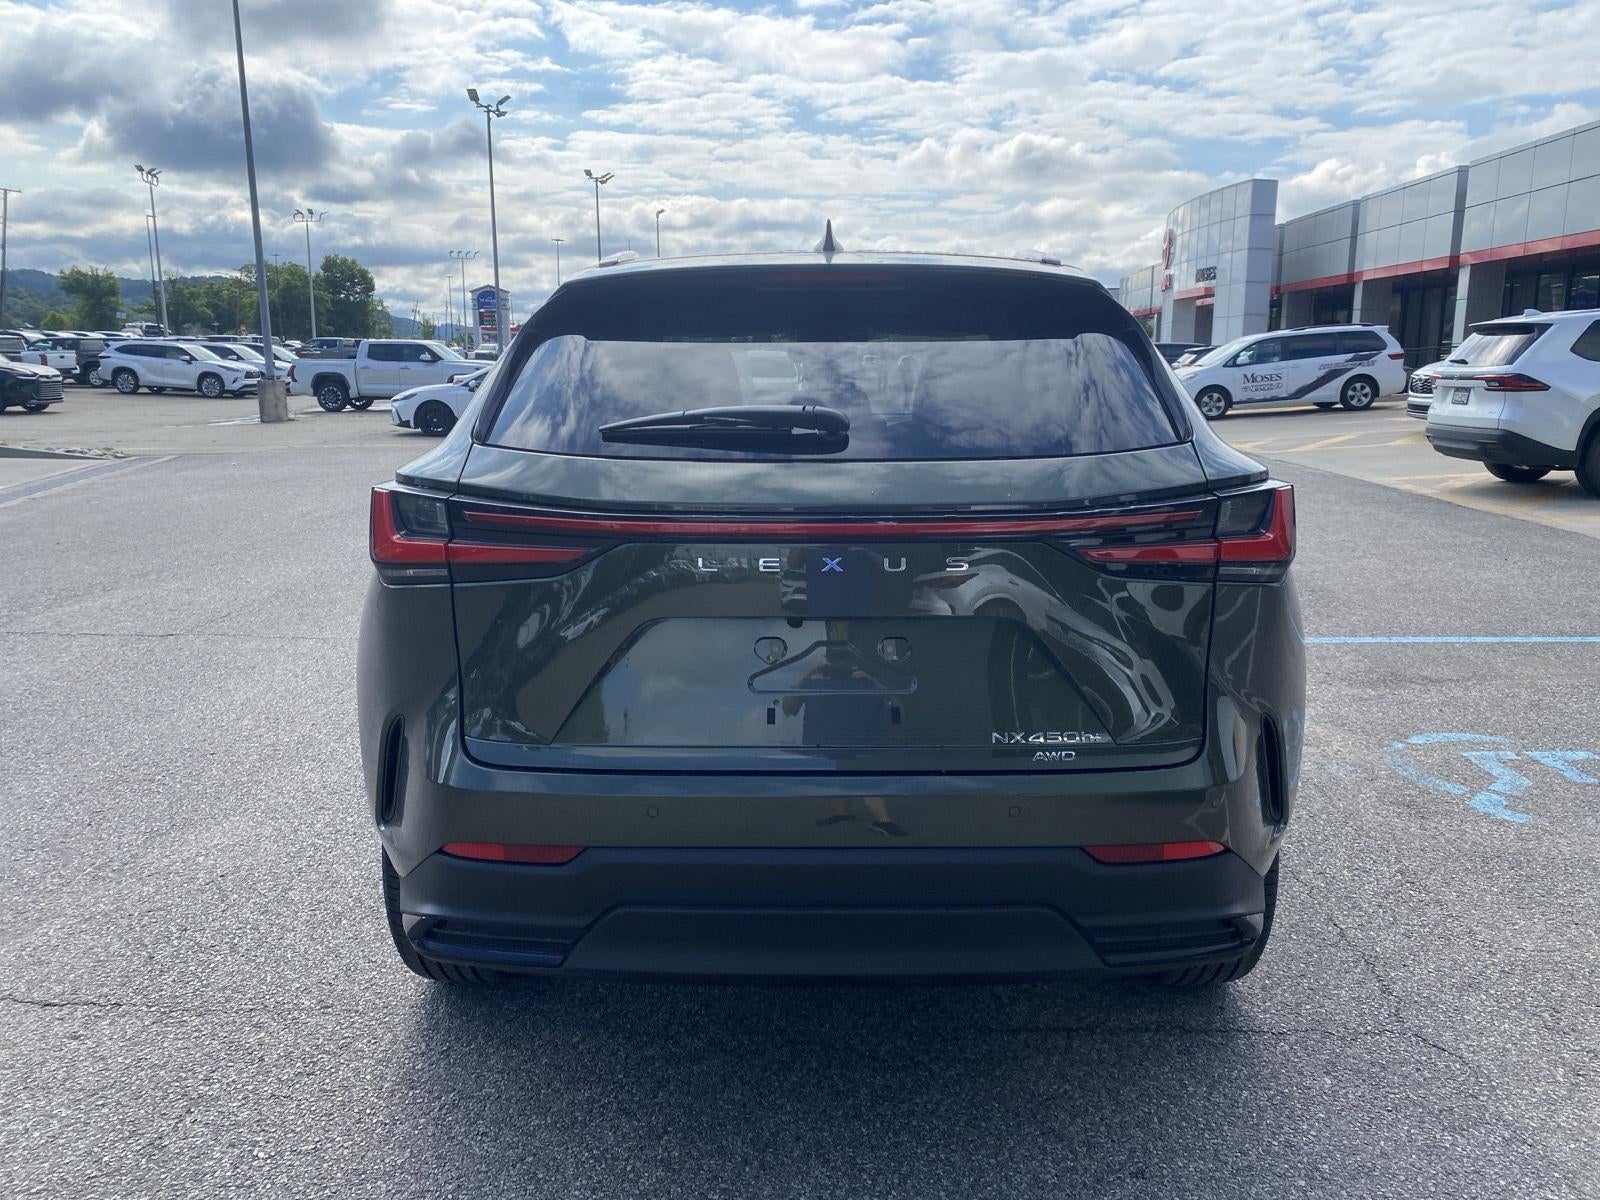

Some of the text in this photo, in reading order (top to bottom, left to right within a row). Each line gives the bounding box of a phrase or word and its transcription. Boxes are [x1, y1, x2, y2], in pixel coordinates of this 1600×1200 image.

[1242, 372, 1282, 384] MOSES
[697, 556, 969, 573] LEXUS
[1032, 751, 1076, 761] AWD
